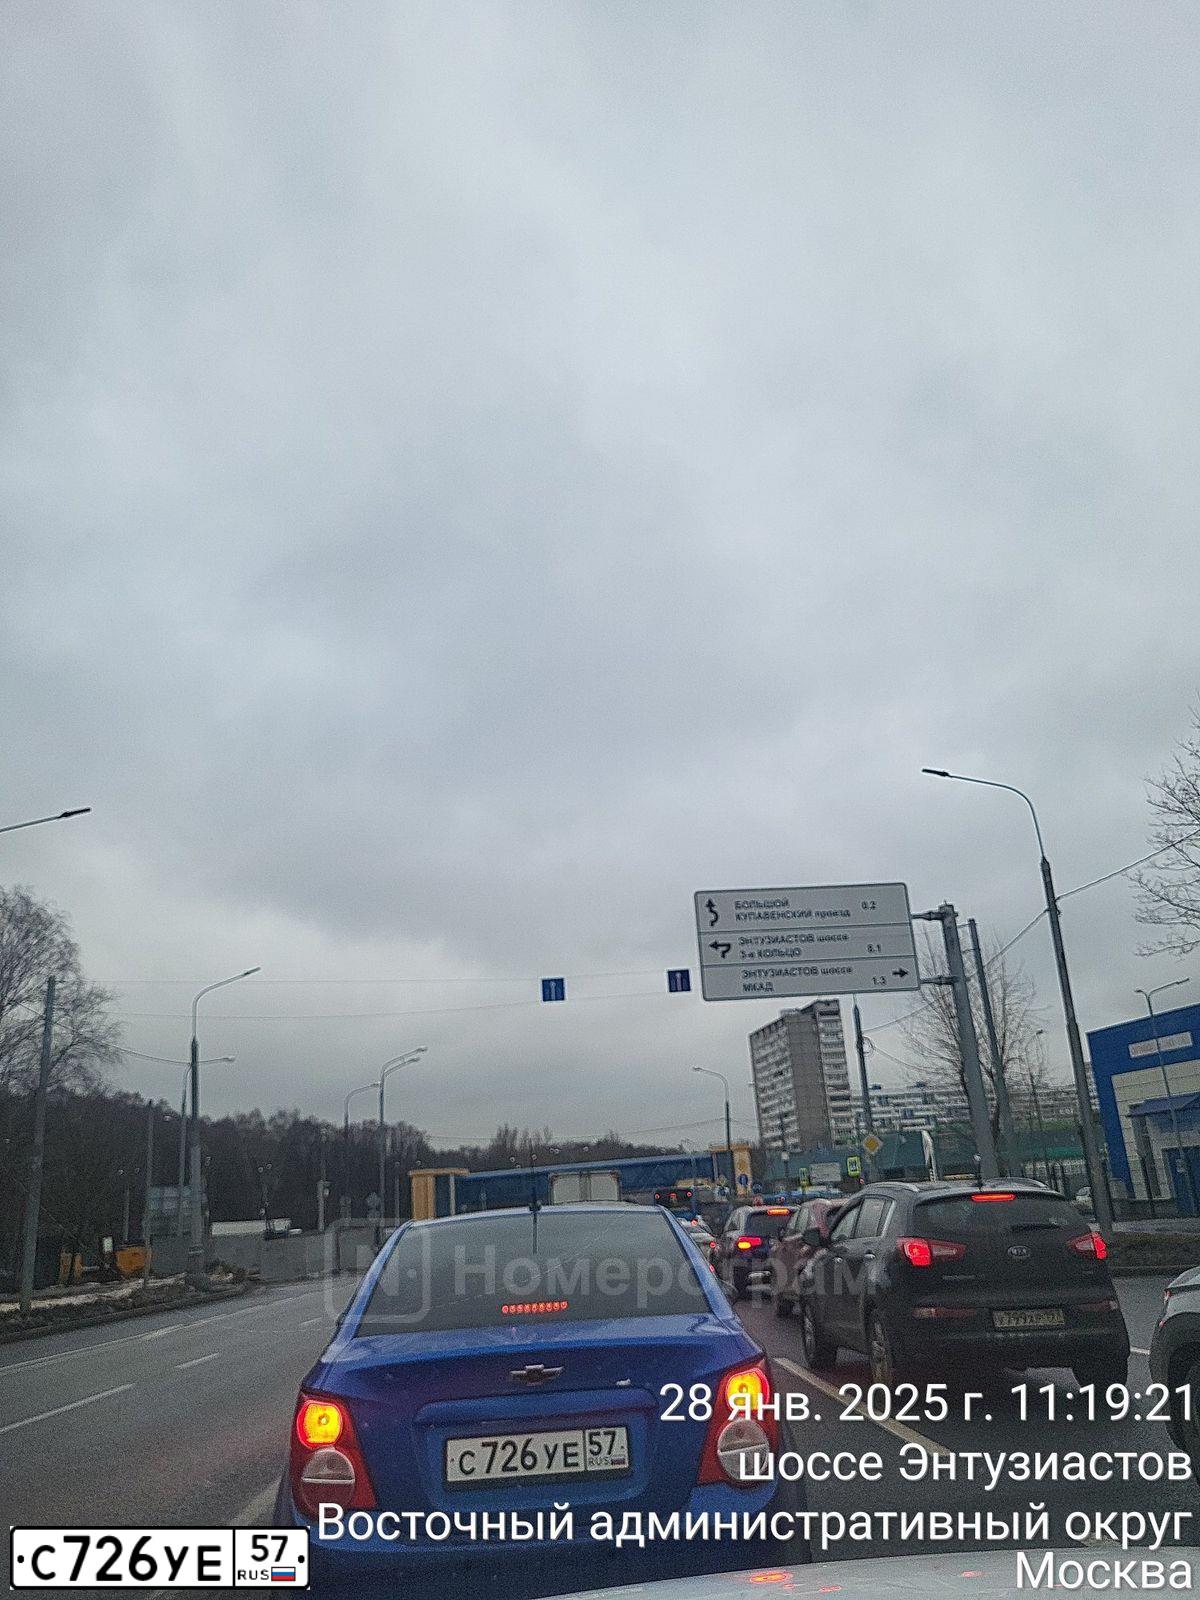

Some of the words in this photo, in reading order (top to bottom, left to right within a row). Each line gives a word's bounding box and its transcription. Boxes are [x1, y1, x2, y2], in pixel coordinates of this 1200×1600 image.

[735, 897, 789, 910] БОЛЬШОЙ
[735, 909, 812, 921] КУПАВЕНСКИЙ
[815, 909, 851, 919] проезд
[738, 933, 815, 945] ЭНТУЗИАСТОВ
[817, 933, 849, 943] шоссе
[758, 947, 801, 959] КОЛЬЦО
[741, 966, 818, 979] ЭНТУЗИАСТОВ
[820, 965, 853, 975] шоссе
[743, 982, 774, 992] МКАД
[588, 1431, 617, 1456] 57
[588, 1457, 610, 1467] RUS
